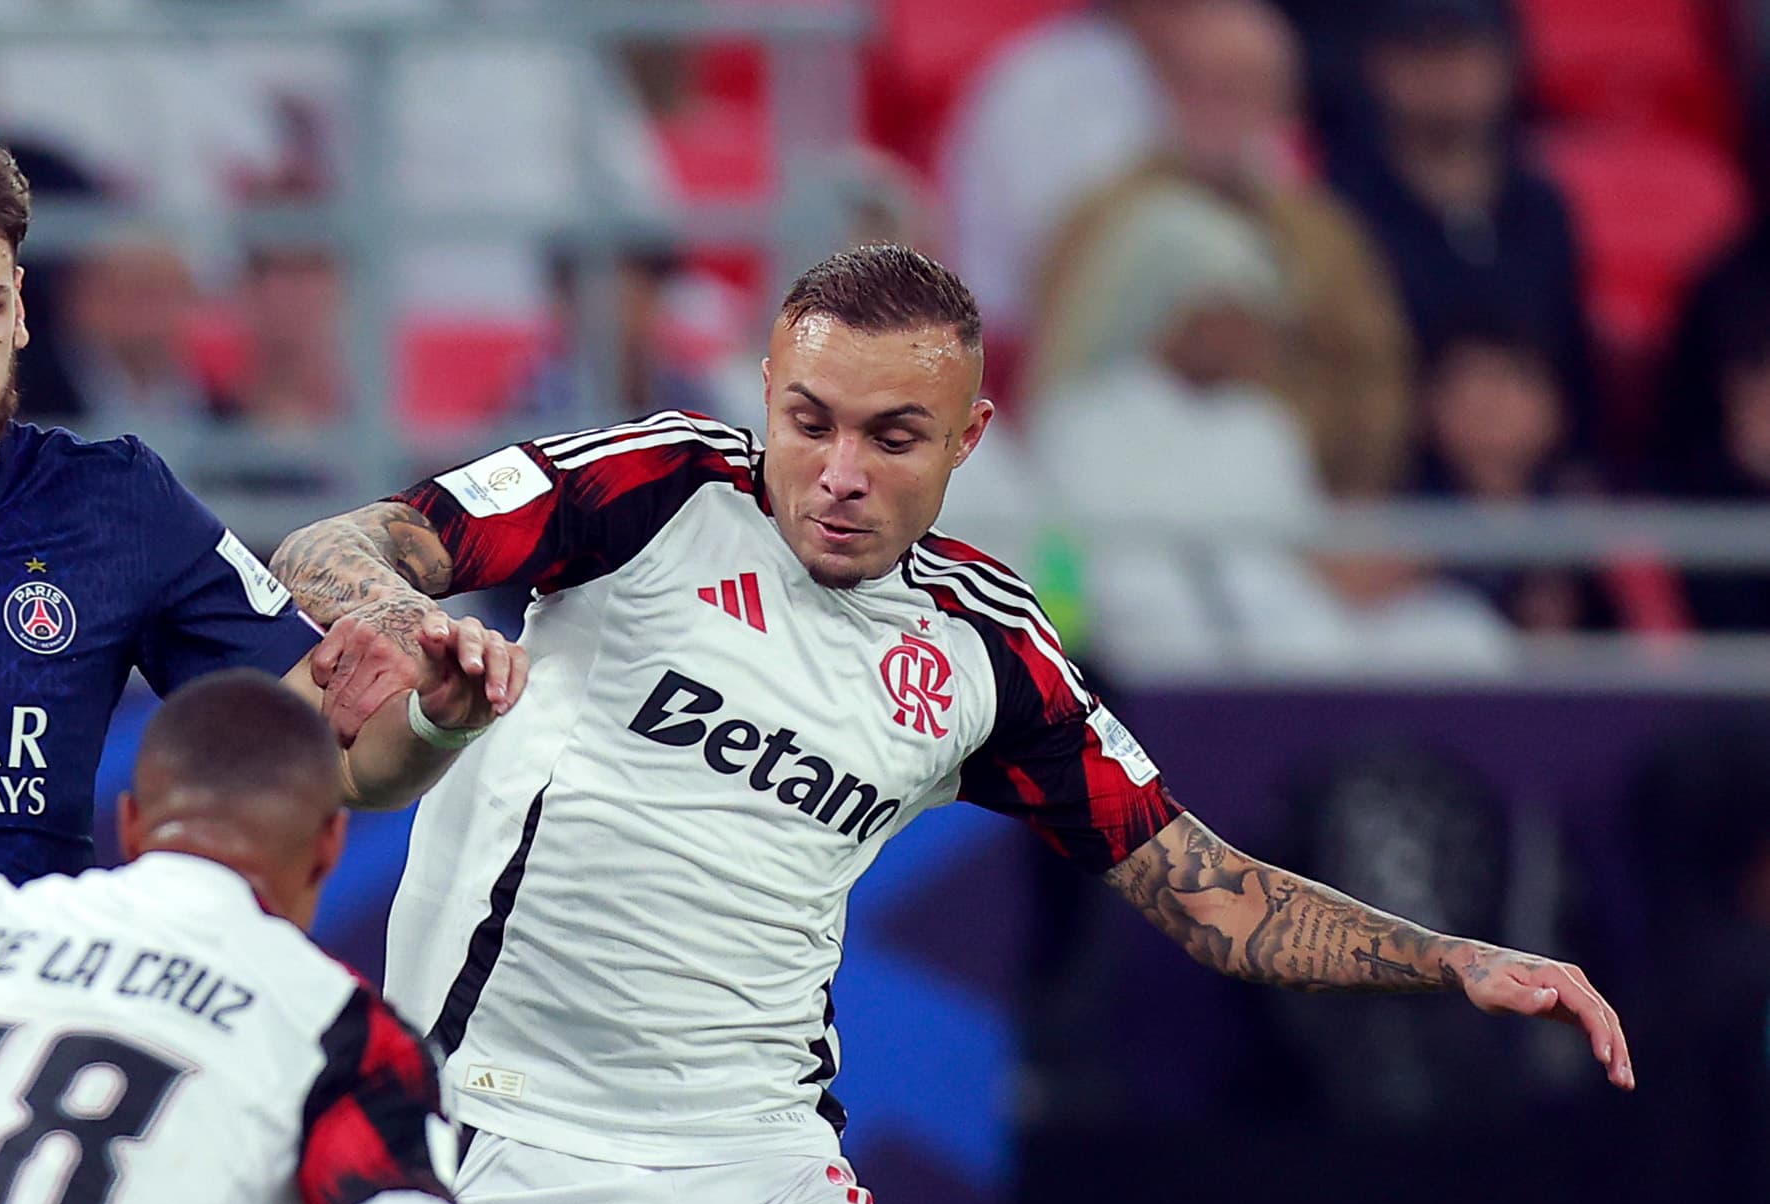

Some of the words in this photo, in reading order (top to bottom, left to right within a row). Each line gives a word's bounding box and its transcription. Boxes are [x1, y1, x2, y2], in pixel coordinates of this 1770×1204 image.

[14, 585, 62, 604] PARIS
[628, 669, 901, 844] Betano
[38, 937, 112, 989] LA
[116, 950, 255, 1033] CRUZ
